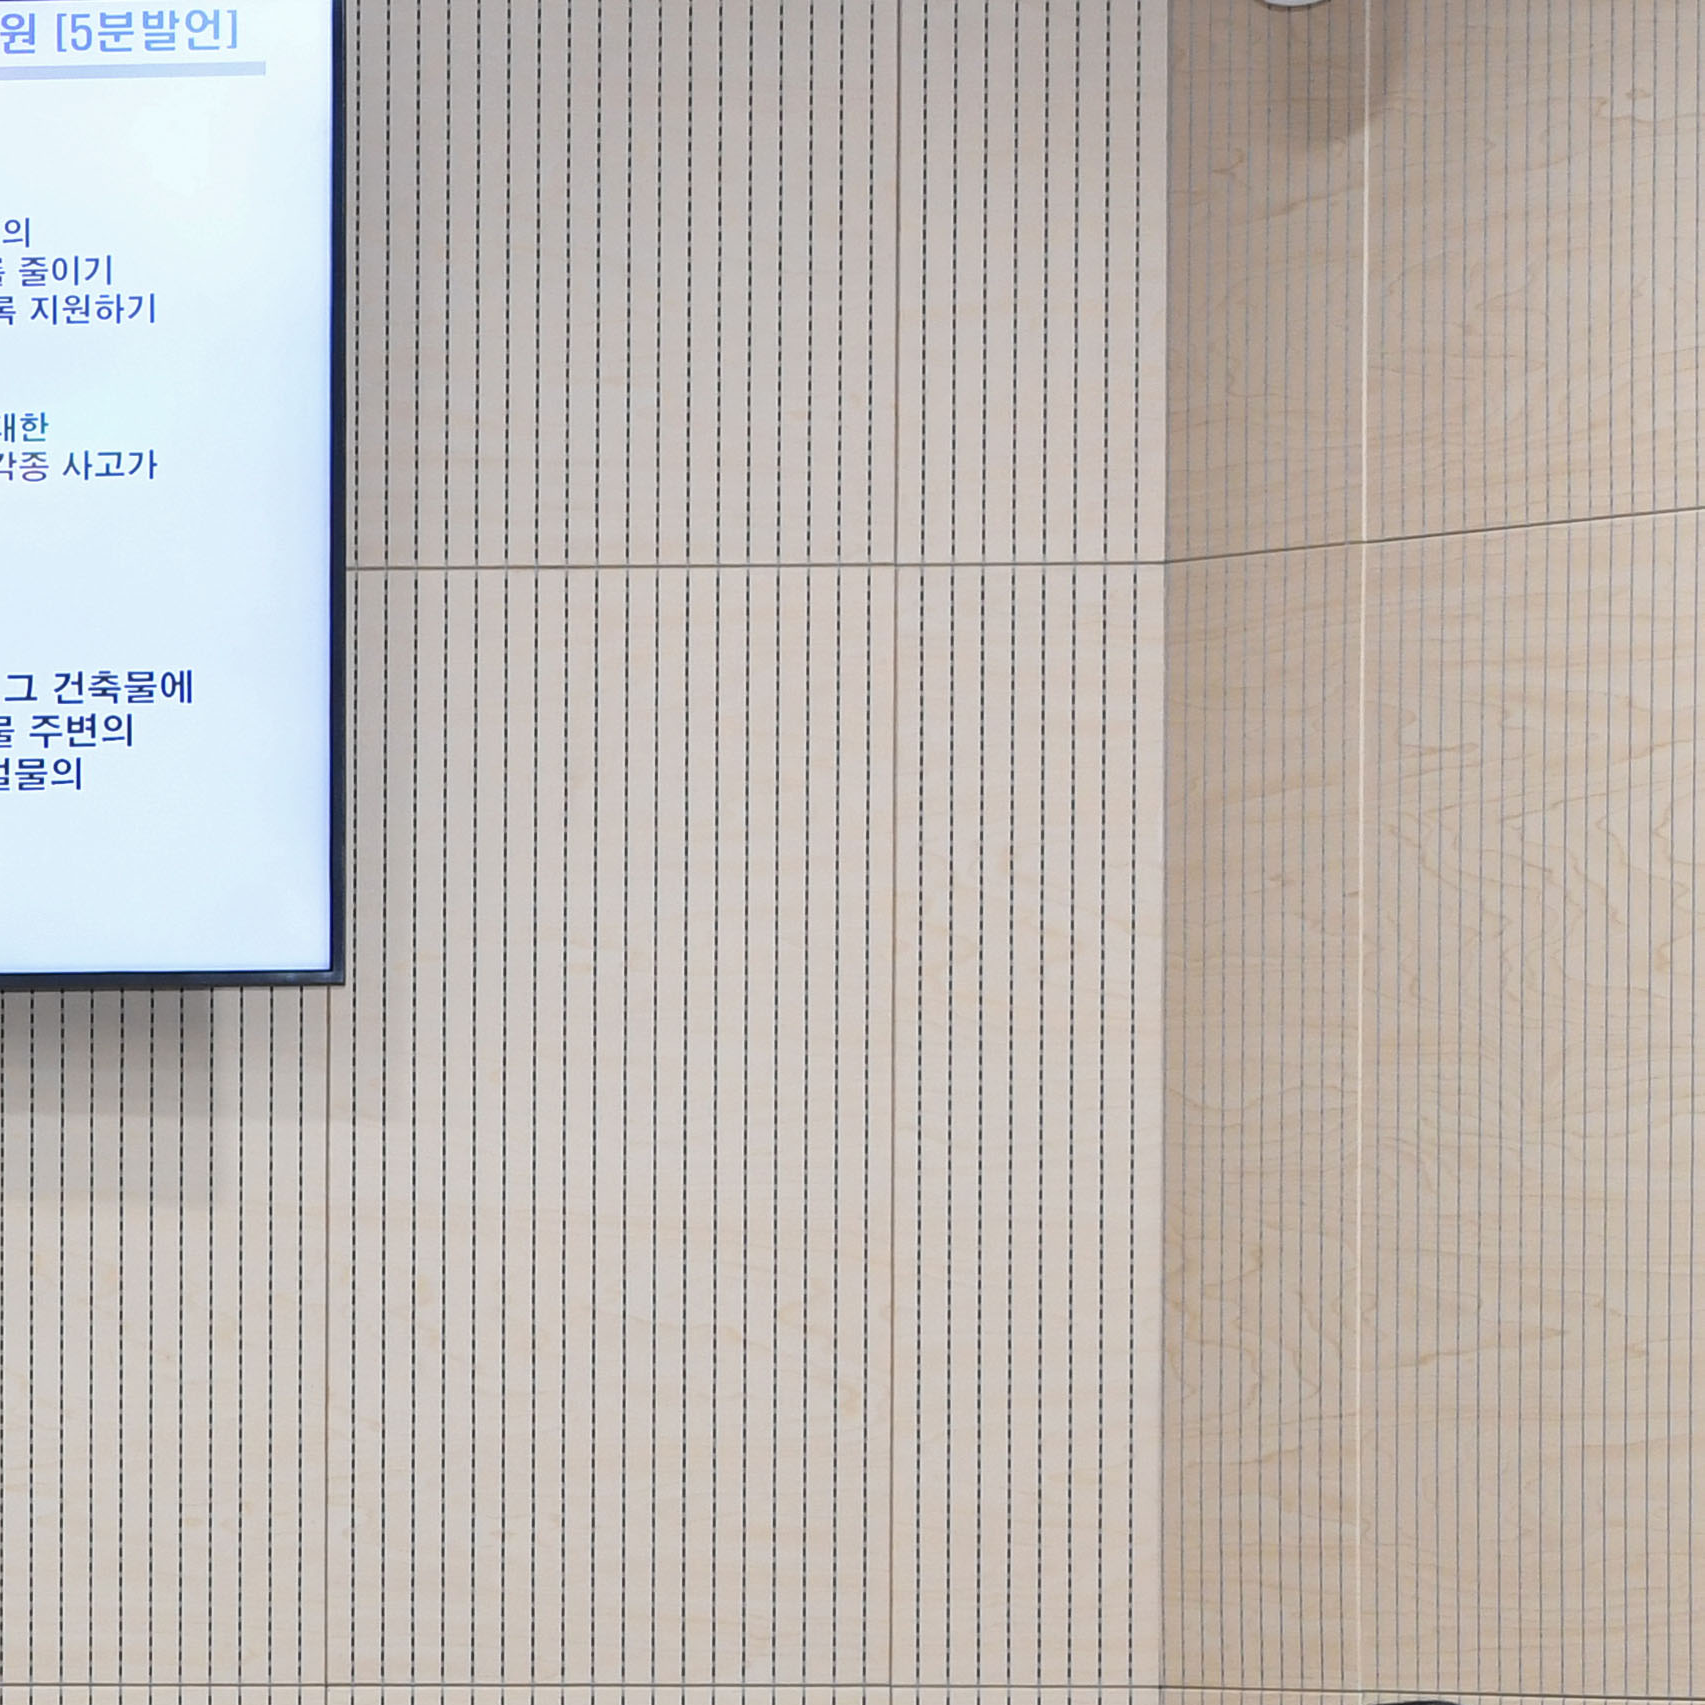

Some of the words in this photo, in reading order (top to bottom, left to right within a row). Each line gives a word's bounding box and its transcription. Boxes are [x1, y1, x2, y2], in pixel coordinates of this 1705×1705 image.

[56, 9, 238, 53] [5분발언]
[19, 255, 112, 288] 줄이기
[30, 292, 155, 326] 지원하기
[63, 449, 158, 481] 사고가
[4, 673, 38, 702] 그
[54, 669, 192, 705] 건축물에
[29, 712, 132, 749] 주변의
